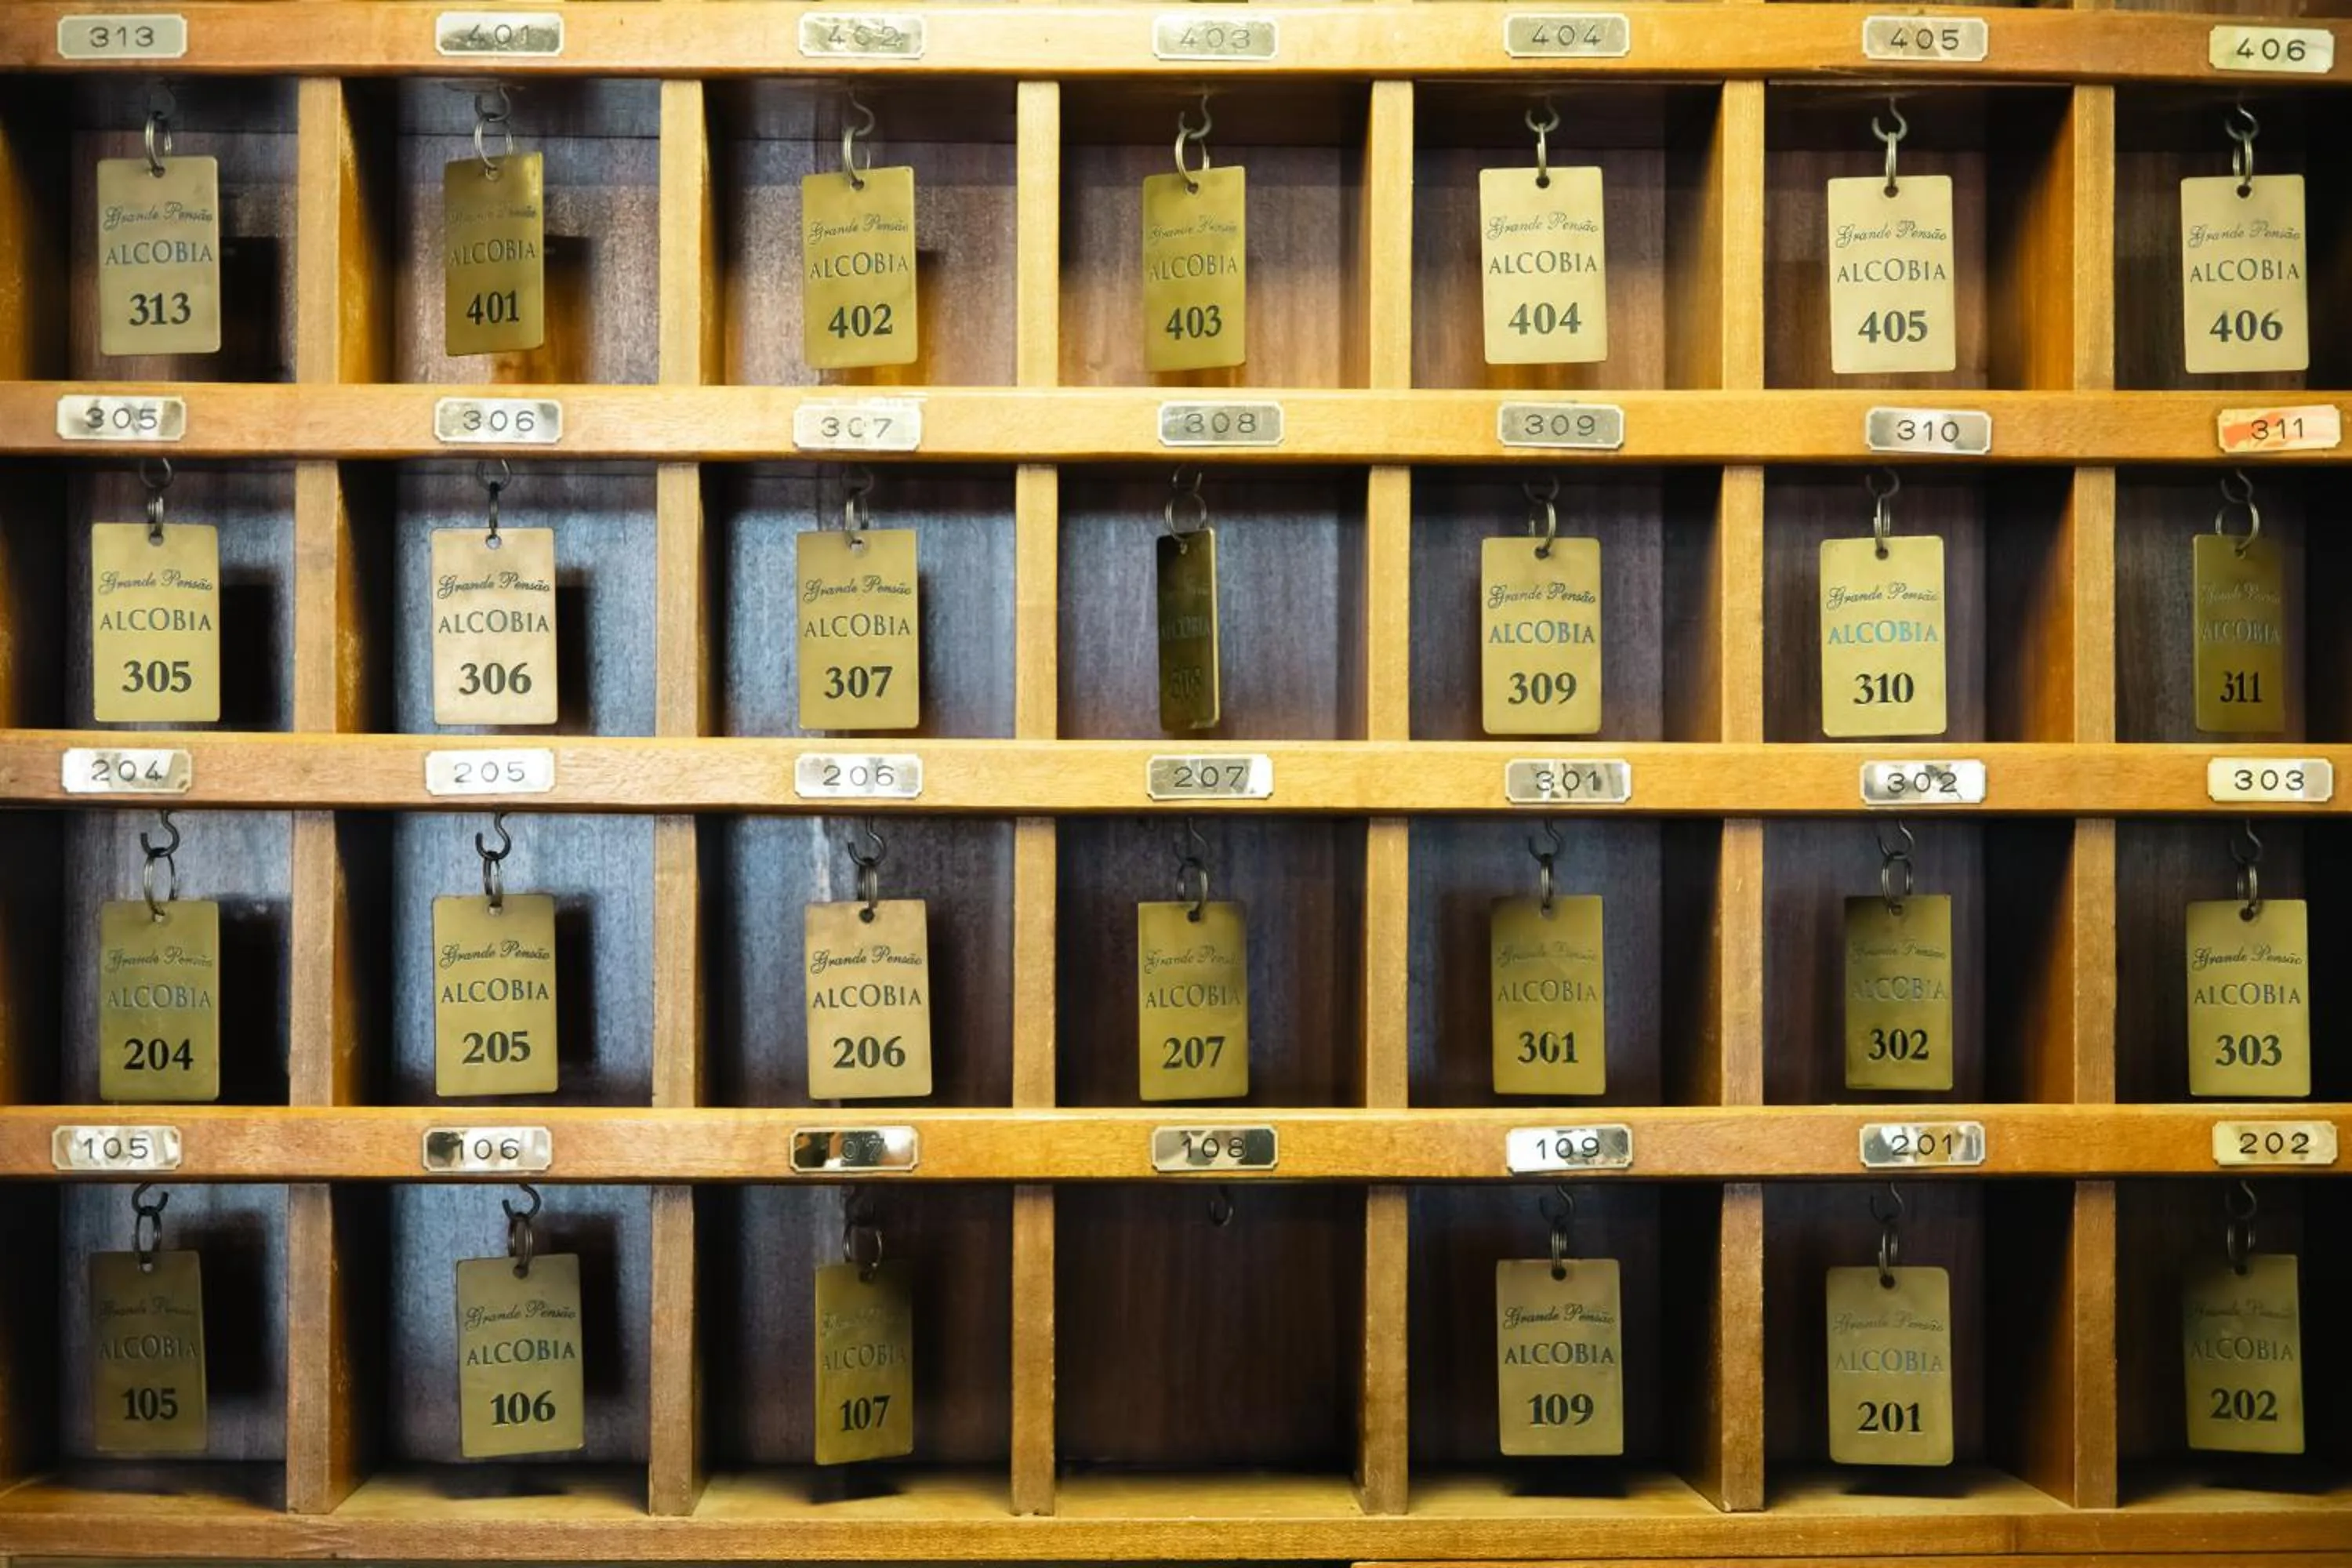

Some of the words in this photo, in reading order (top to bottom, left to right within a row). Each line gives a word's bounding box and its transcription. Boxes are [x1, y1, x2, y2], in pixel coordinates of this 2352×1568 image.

[89, 26, 154, 48] 313
[469, 24, 532, 45] 401
[828, 26, 898, 46] 402
[1180, 27, 1250, 49] 403
[1532, 25, 1601, 45] 404
[1891, 28, 1959, 50] 405
[2237, 38, 2306, 61] 406
[103, 206, 158, 230] Grande
[163, 201, 213, 223] Pensão
[1486, 215, 1542, 240] Grande
[1547, 211, 1598, 233] Pensão
[808, 222, 858, 245] Grande
[862, 213, 909, 233] Pensão
[1836, 223, 1890, 249] Grande
[1896, 220, 1947, 241] Pensão
[2188, 223, 2245, 248] Grande
[2249, 221, 2300, 241] Pensão
[106, 240, 213, 265] ALCOBIA
[450, 239, 535, 267] ALCOBIA
[810, 252, 909, 279] ALCOBIA
[1489, 250, 1597, 274] ALCOBIA
[1149, 253, 1237, 281] ALCOBIA
[1837, 258, 1946, 282] ALCOBIA
[2190, 258, 2299, 283] ALCOBIA
[129, 292, 191, 326] 313
[466, 290, 520, 325] 401
[1508, 302, 1582, 335] 404
[828, 303, 893, 339] 402
[1164, 305, 1222, 340] 403
[1858, 310, 1928, 343] 405
[2209, 309, 2283, 343] 406
[86, 407, 157, 430] 305
[463, 410, 535, 431] 306
[821, 417, 892, 438] 307
[1185, 412, 1256, 434] 308
[1525, 414, 1595, 436] 309
[1897, 420, 1959, 442] 310
[2252, 418, 2303, 440] 311
[98, 571, 156, 594] Grande
[161, 568, 212, 591] Pensão
[437, 574, 494, 599] Grande
[499, 572, 550, 592] Pensão
[803, 579, 858, 604] Grande
[862, 575, 911, 596] Pensão
[1488, 584, 1541, 609] Grande
[1546, 582, 1595, 603] Pensão
[1827, 586, 1882, 610] Grande
[1887, 582, 1937, 601] Pensão
[100, 608, 212, 631] ALCOBIA
[438, 610, 550, 633] ALCOBIA
[804, 613, 910, 637] ALCOBIA
[1489, 621, 1595, 644] ALCOBIA
[1828, 620, 1938, 644] ALCOBIA
[2201, 618, 2281, 644] ALCOBIA
[122, 661, 192, 692] 305
[459, 662, 532, 695] 306
[824, 666, 893, 699] 307
[1508, 673, 1577, 705] 309
[1853, 673, 1914, 705] 310
[2220, 671, 2263, 703] 311
[91, 760, 162, 782] 204
[454, 761, 525, 783] 205
[823, 765, 894, 786] 206
[1174, 767, 1244, 787] 207
[1536, 771, 1599, 791] 301
[1887, 772, 1957, 793] 302
[2234, 769, 2304, 790] 303
[439, 944, 495, 969] Grande
[500, 940, 550, 960] Pensão
[811, 949, 866, 974] Grande
[872, 946, 922, 966] Pensão
[1144, 949, 1194, 974] Grande
[2191, 946, 2246, 971] Grande
[2251, 942, 2303, 965] Pensão
[108, 984, 211, 1009] ALCOBIA
[441, 978, 549, 1003] ALCOBIA
[813, 984, 921, 1008] ALCOBIA
[1146, 984, 1241, 1008] ALCOBIA
[1498, 980, 1598, 1003] ALCOBIA
[2194, 983, 2301, 1005] ALCOBIA
[124, 1038, 194, 1071] 204
[463, 1031, 531, 1064] 205
[833, 1036, 906, 1069] 206
[1163, 1036, 1225, 1069] 207
[1518, 1031, 1578, 1064] 301
[1868, 1029, 1929, 1061] 302
[2216, 1035, 2282, 1066] 303
[82, 1138, 148, 1159] 105
[457, 1139, 519, 1160] 106
[1181, 1138, 1245, 1158] 108
[1537, 1137, 1599, 1160] 109
[1891, 1134, 1951, 1156] 201
[2240, 1132, 2309, 1154] 202
[465, 1305, 521, 1330] Grande
[525, 1301, 576, 1319] Pensão
[1502, 1306, 1559, 1330] Grande
[1564, 1304, 1614, 1323] Pensão
[99, 1334, 198, 1360] ALCOBIA
[467, 1338, 575, 1365] ALCOBIA
[822, 1343, 907, 1370] ALCOBIA
[1504, 1342, 1614, 1364] ALCOBIA
[1835, 1348, 1944, 1372] ALCOBIA
[2193, 1338, 2293, 1361] ALCOBIA
[121, 1388, 178, 1421] 105
[490, 1391, 556, 1425] 106
[840, 1396, 891, 1431] 107
[1528, 1394, 1594, 1425] 109
[1857, 1402, 1923, 1432] 201
[2210, 1388, 2278, 1421] 202
